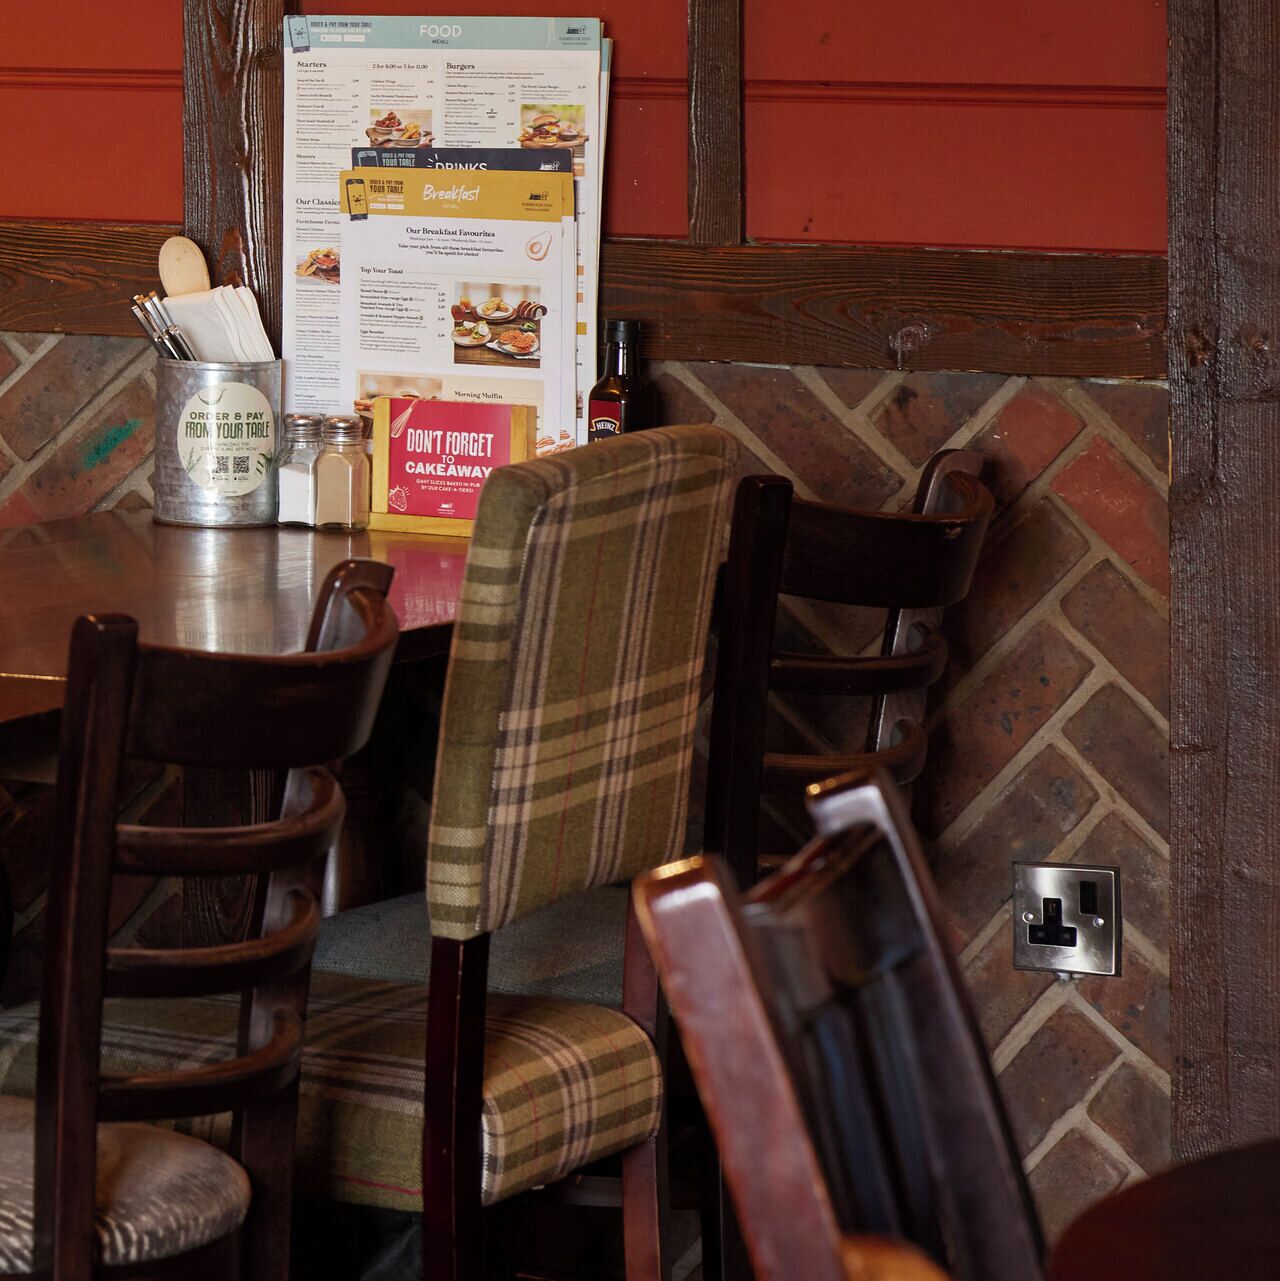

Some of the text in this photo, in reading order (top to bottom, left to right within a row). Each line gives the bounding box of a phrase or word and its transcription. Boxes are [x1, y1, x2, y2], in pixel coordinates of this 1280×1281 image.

[420, 24, 462, 38] FOOD
[446, 62, 475, 70] Burgers
[435, 162, 487, 170] DRINKS
[370, 185, 403, 194] YOUR TABLE
[423, 184, 480, 201] Breakfast
[422, 227, 457, 235] Breakfast
[459, 229, 495, 237] Favourites
[454, 391, 480, 399] Morning
[189, 412, 264, 420] ORDER & PAY
[216, 422, 243, 439] YOUR
[245, 421, 270, 438] TABLE
[596, 421, 615, 431] HEINZ
[406, 428, 494, 457] DON'T FORGET
[441, 455, 455, 464] TO
[405, 461, 493, 478] CAKEAWAY
